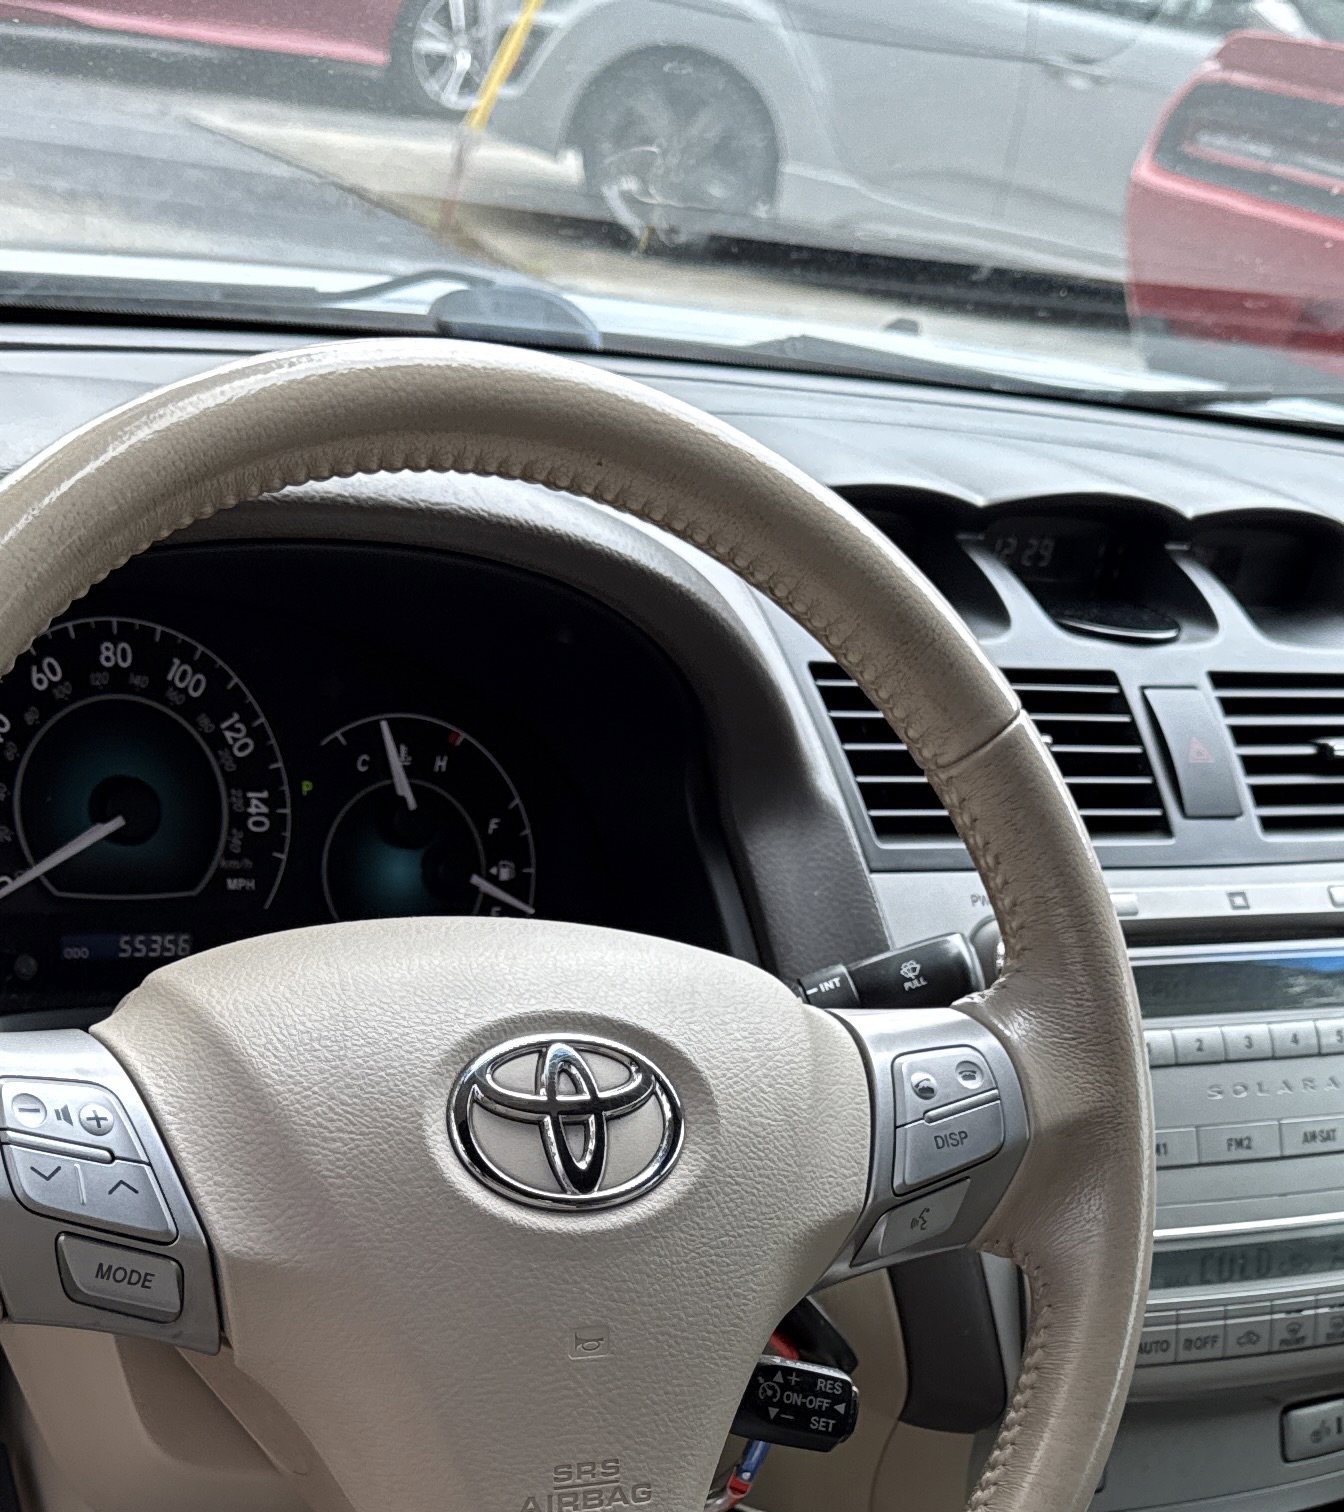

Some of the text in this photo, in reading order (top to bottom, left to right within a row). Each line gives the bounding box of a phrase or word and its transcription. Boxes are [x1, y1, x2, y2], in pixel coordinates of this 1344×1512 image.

[99, 641, 133, 669] 80
[30, 656, 64, 692] 60
[166, 657, 207, 698] 100
[219, 712, 254, 758] 120
[357, 754, 449, 773] C H
[301, 780, 313, 796] P
[246, 790, 270, 834] 140
[487, 818, 502, 835] F
[226, 877, 256, 891] MPH
[63, 935, 192, 959] ODO 55356
[818, 977, 841, 992] INT
[903, 976, 927, 991] PULL
[1195, 1038, 1204, 1052] 2
[1244, 1035, 1253, 1049] 3
[1290, 1032, 1299, 1047] 4
[1336, 1028, 1344, 1044] 5
[1207, 1075, 1342, 1100] SOLARA
[933, 1130, 969, 1150] DISP
[1226, 1136, 1253, 1152] FM2
[95, 1262, 156, 1290] MODE
[1193, 1334, 1219, 1350] OFF
[816, 1378, 843, 1395] RES
[783, 1391, 832, 1411] ON-OFF
[809, 1416, 837, 1432] SET
[553, 1457, 621, 1484] SRS
